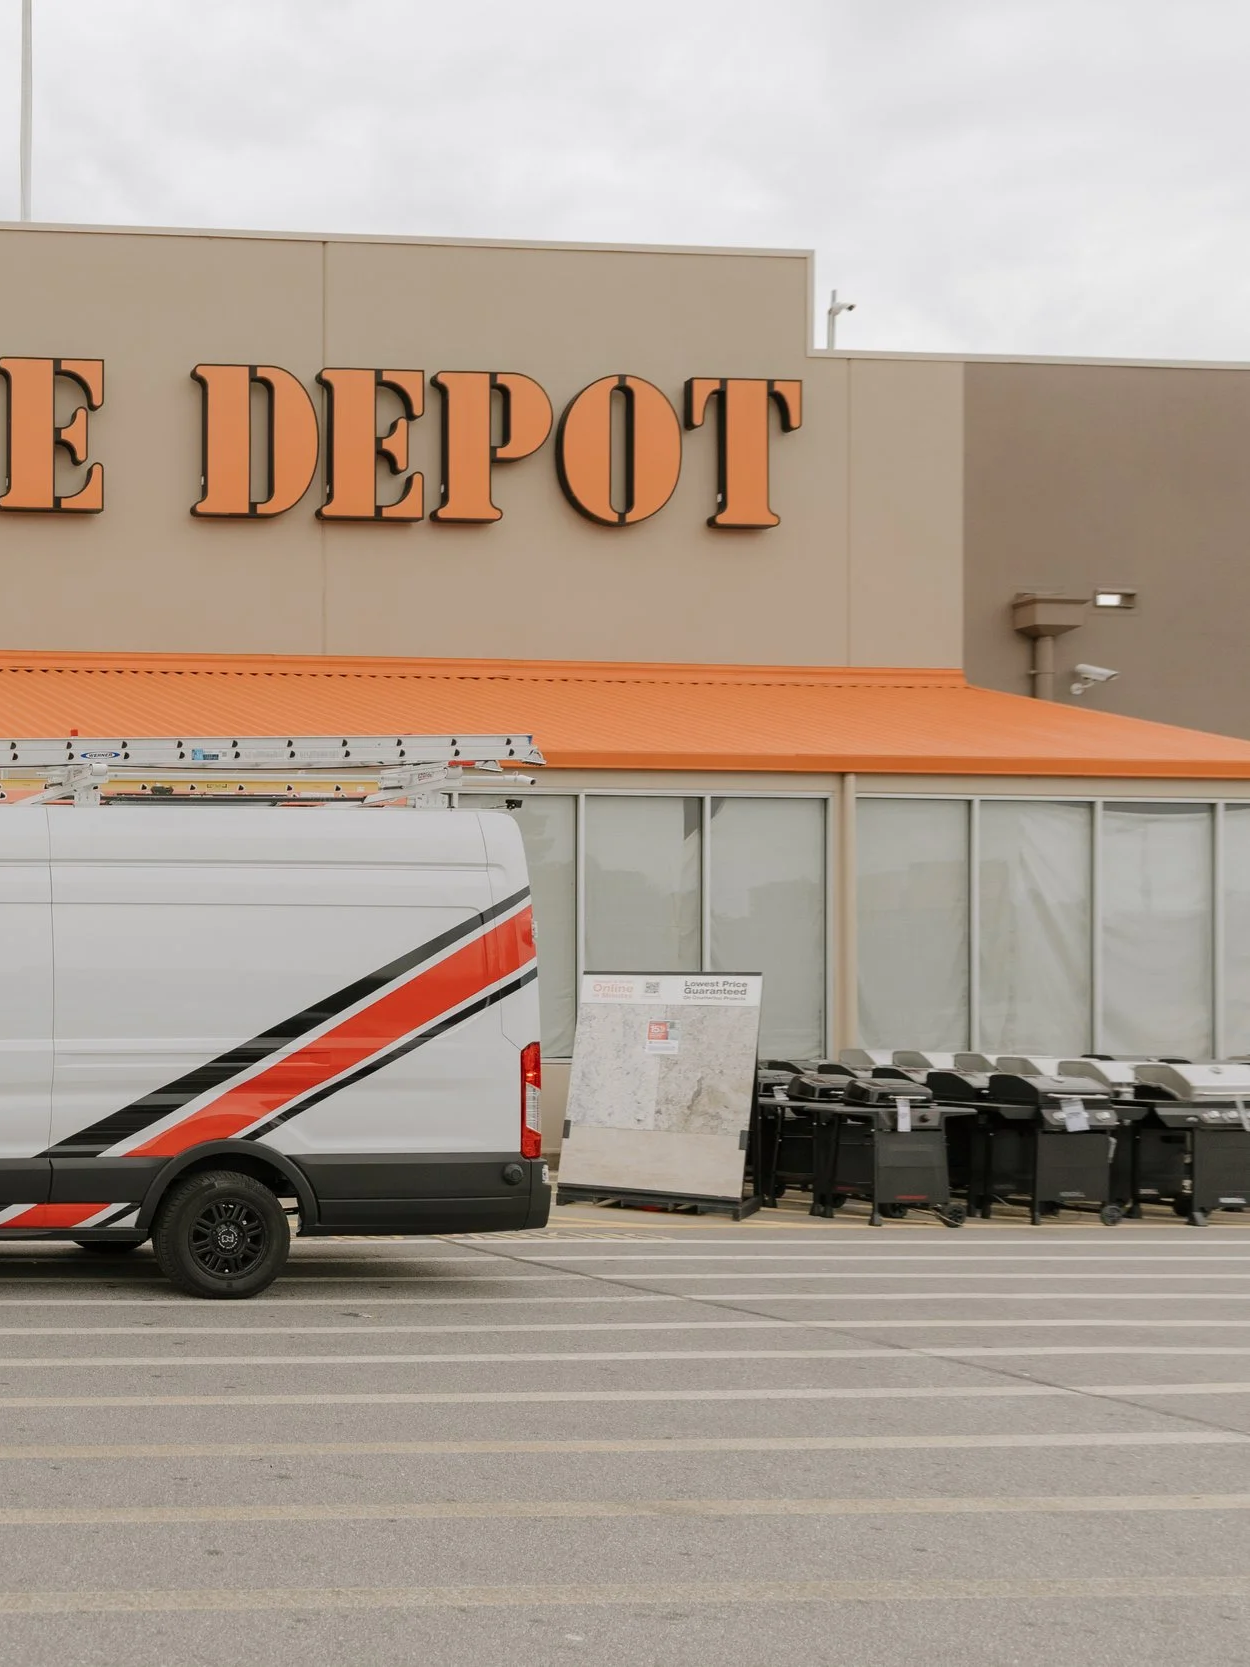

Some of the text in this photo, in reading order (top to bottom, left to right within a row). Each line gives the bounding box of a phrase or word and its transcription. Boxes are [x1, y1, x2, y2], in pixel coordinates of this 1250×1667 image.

[191, 363, 803, 530] DEPOT
[593, 984, 634, 993] Online
[684, 980, 719, 988] Lowest
[684, 987, 747, 996] Guaranteed
